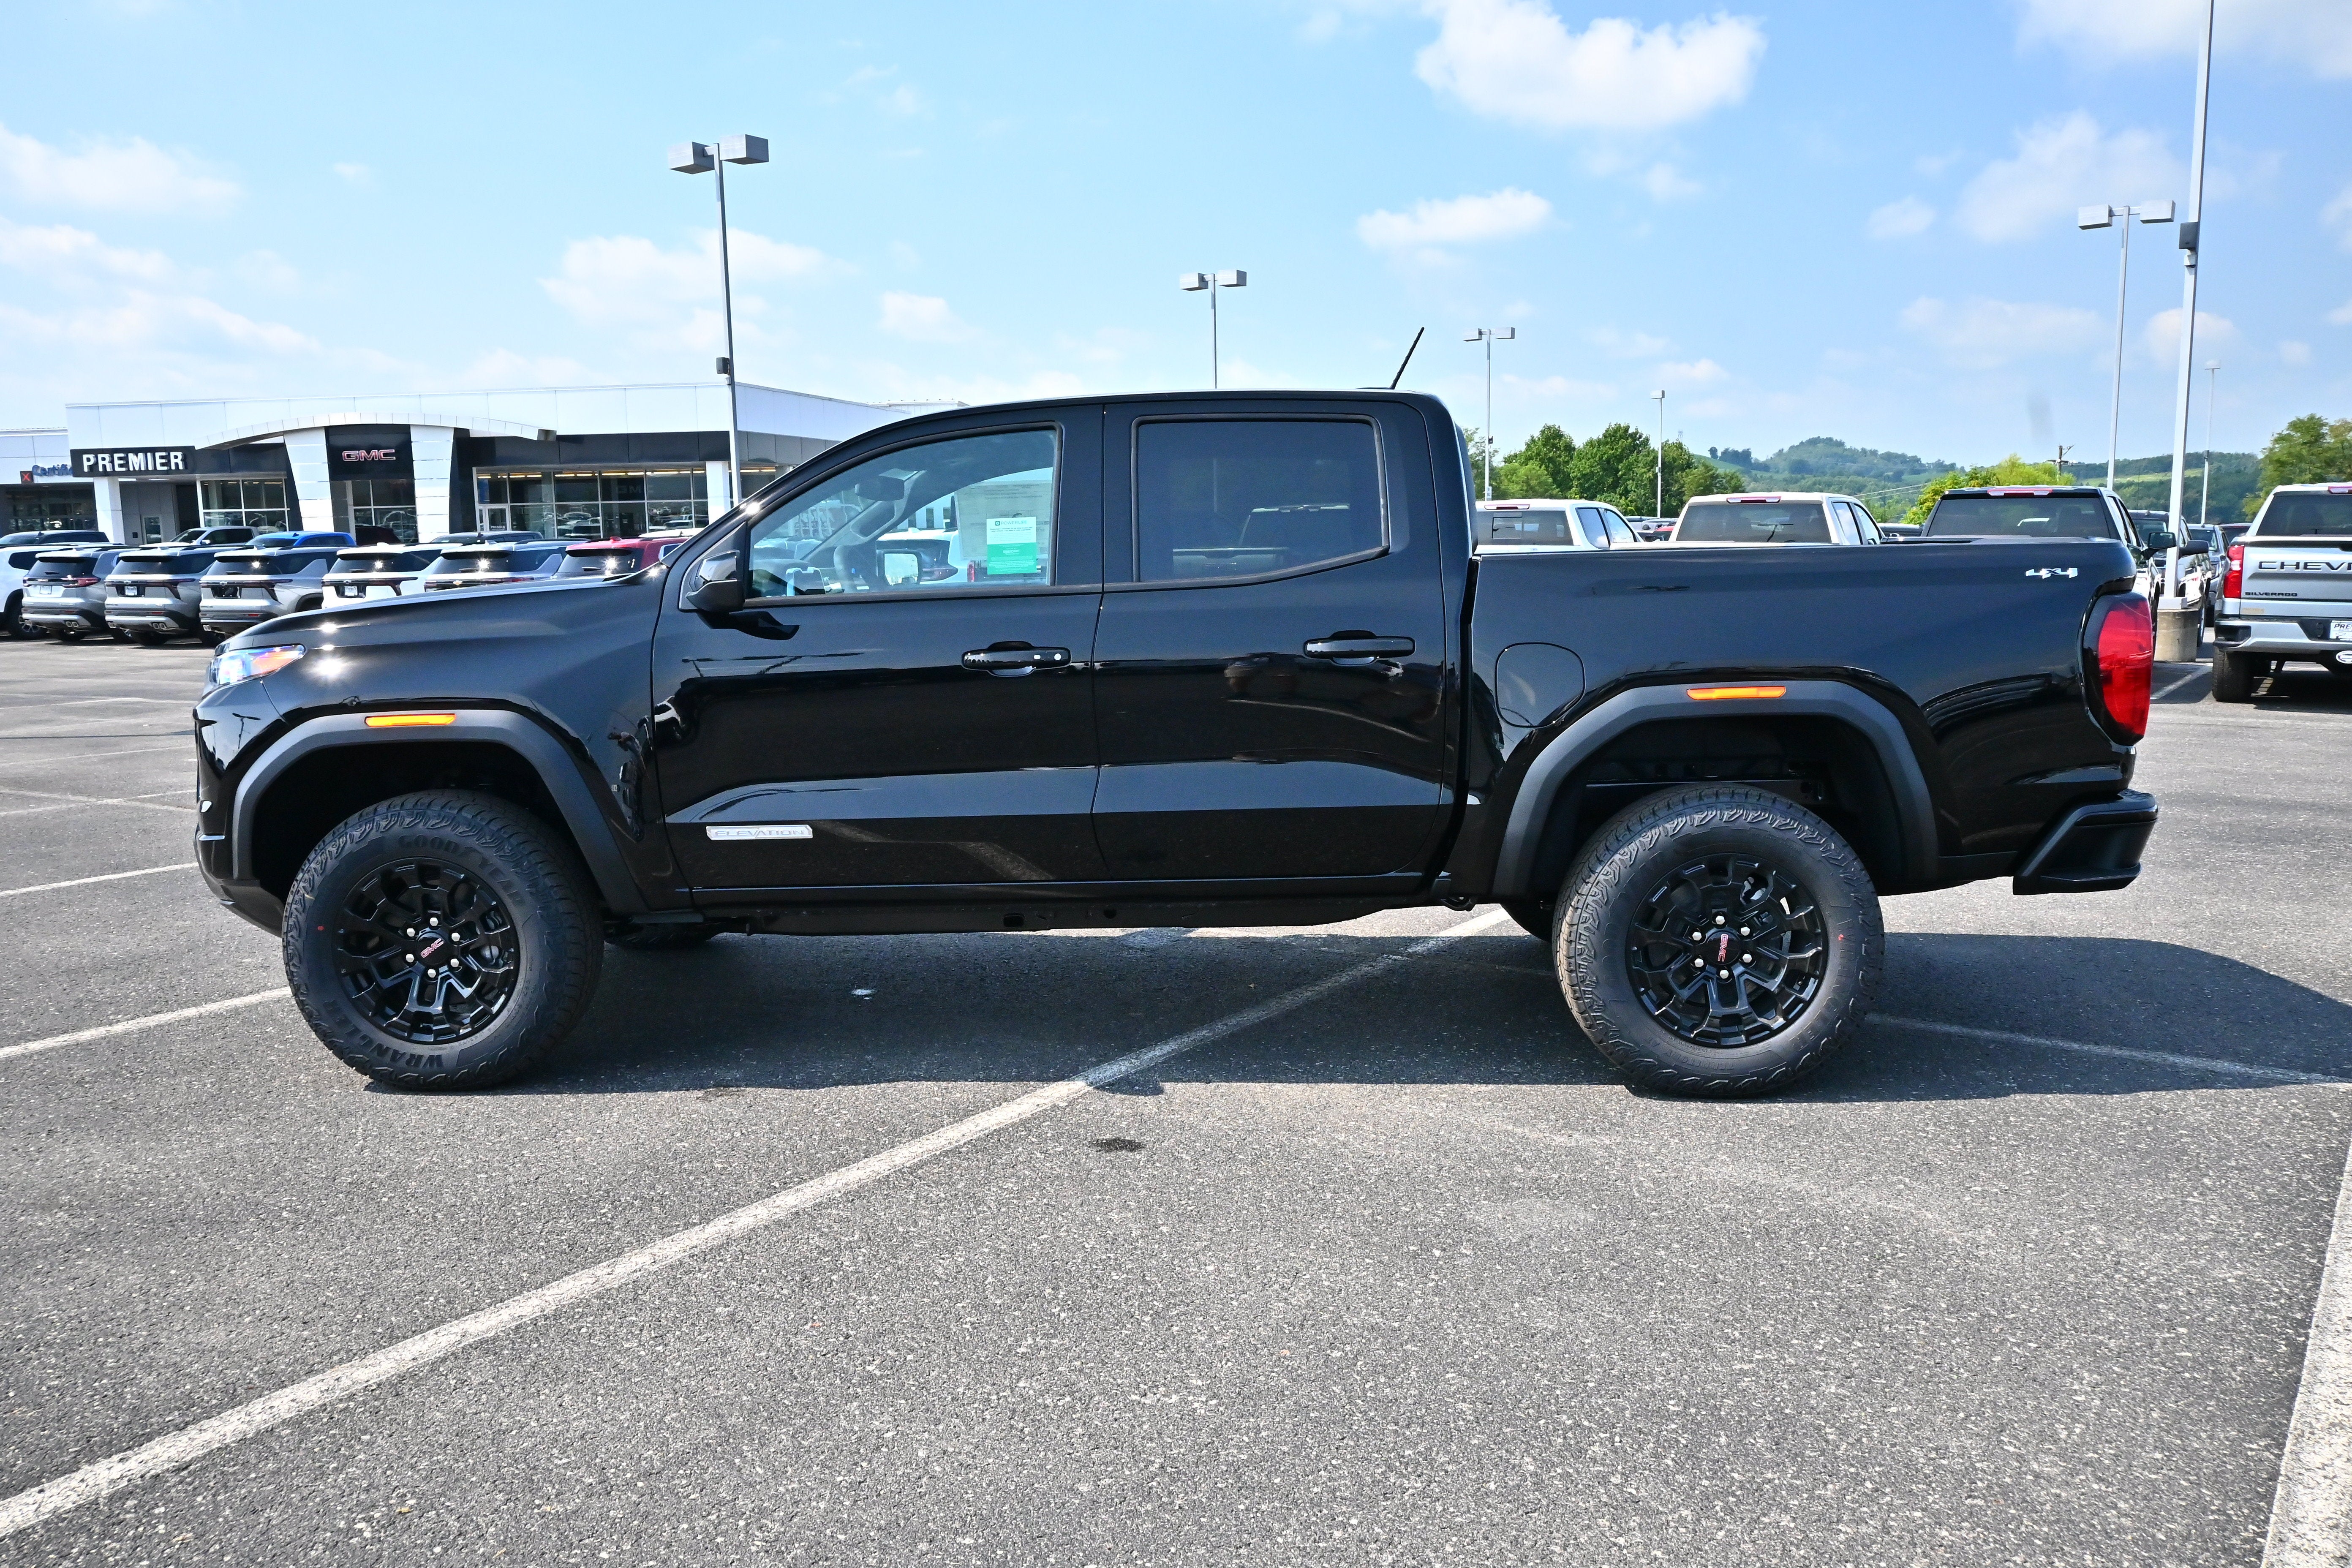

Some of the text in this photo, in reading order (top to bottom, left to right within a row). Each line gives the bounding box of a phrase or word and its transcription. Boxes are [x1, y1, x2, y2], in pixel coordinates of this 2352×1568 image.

[82, 452, 185, 472] PREMIER
[342, 449, 396, 462] GMC
[420, 938, 444, 958] GMC
[1717, 933, 1729, 962] GMC
[323, 999, 444, 1068] WRANGLER
